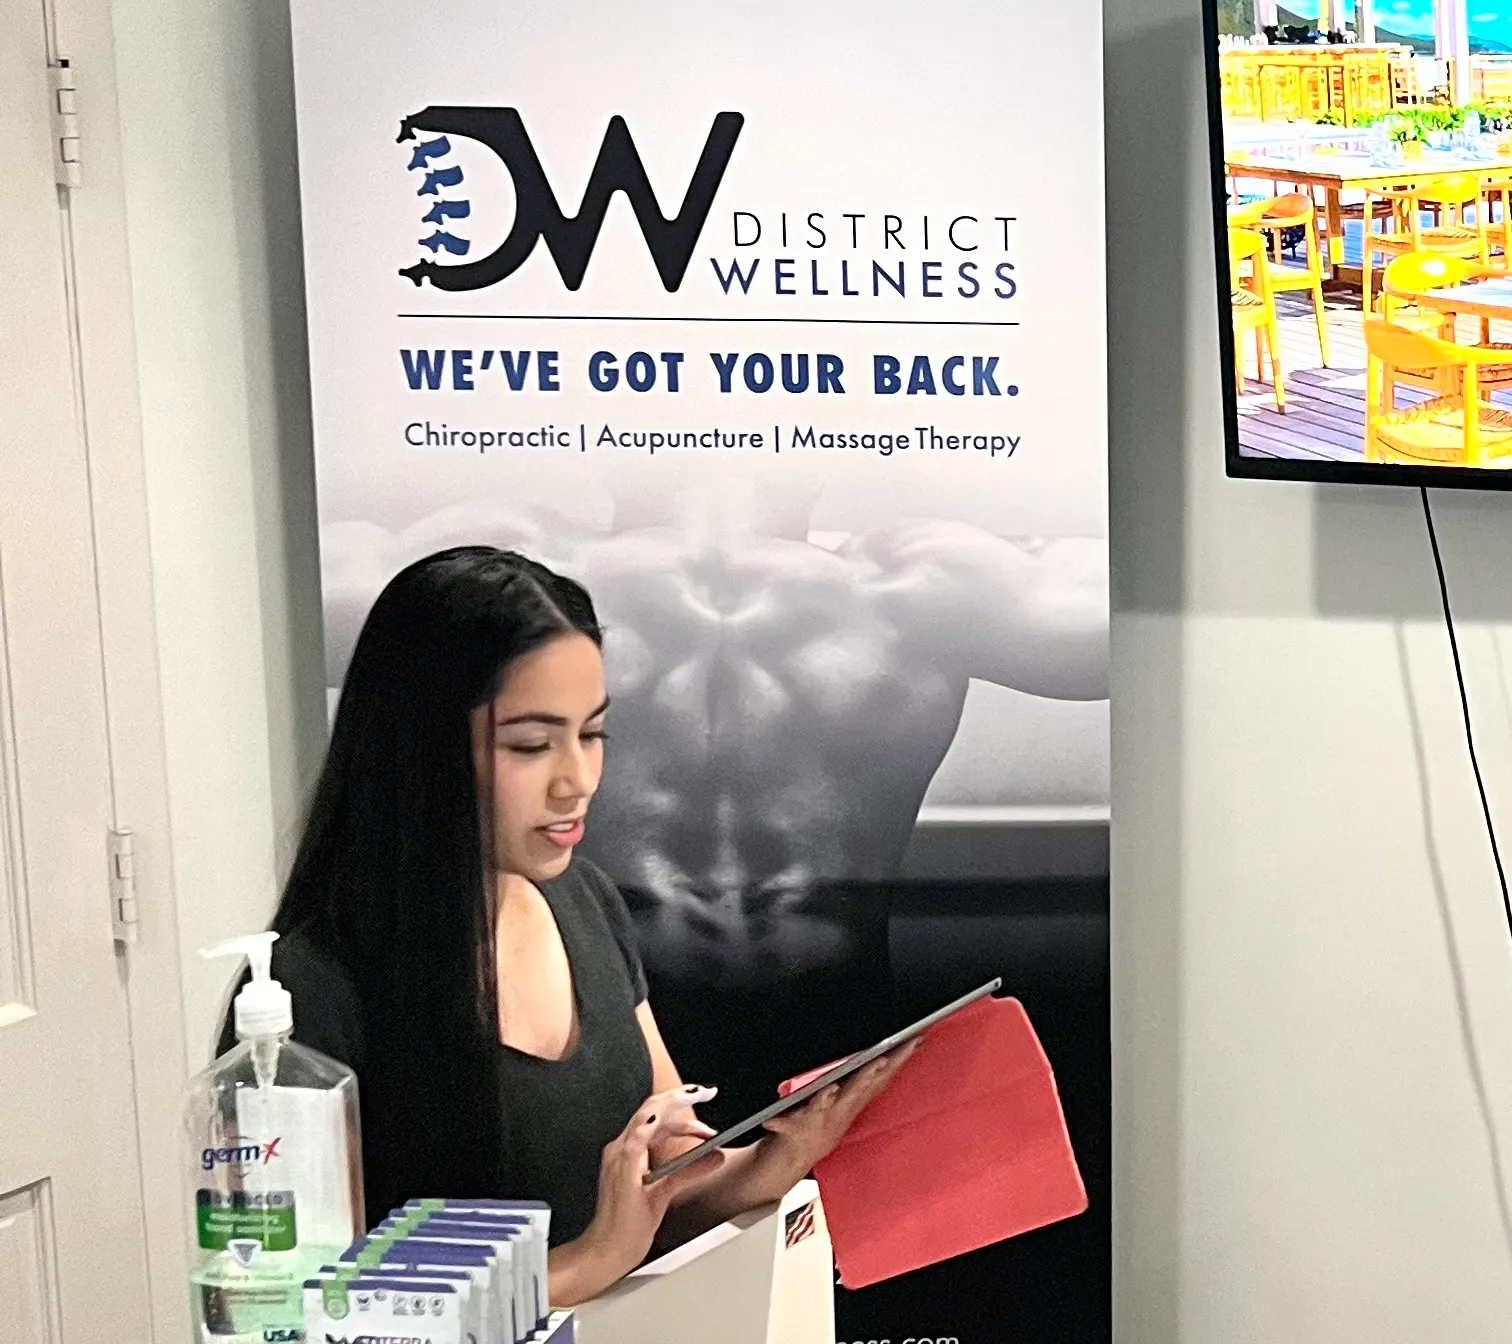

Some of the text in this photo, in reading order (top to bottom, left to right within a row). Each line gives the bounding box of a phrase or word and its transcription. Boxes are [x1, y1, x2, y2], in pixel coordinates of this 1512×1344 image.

[733, 211, 1018, 252] DISTRICT
[709, 258, 1018, 299] WELLNESS
[400, 349, 1020, 397] WE'VE GOT YOUR BACK.
[404, 421, 570, 454] Chiropractic
[596, 424, 764, 454] Acupuncture
[792, 425, 910, 457] Massage
[914, 425, 1021, 458] Therapy
